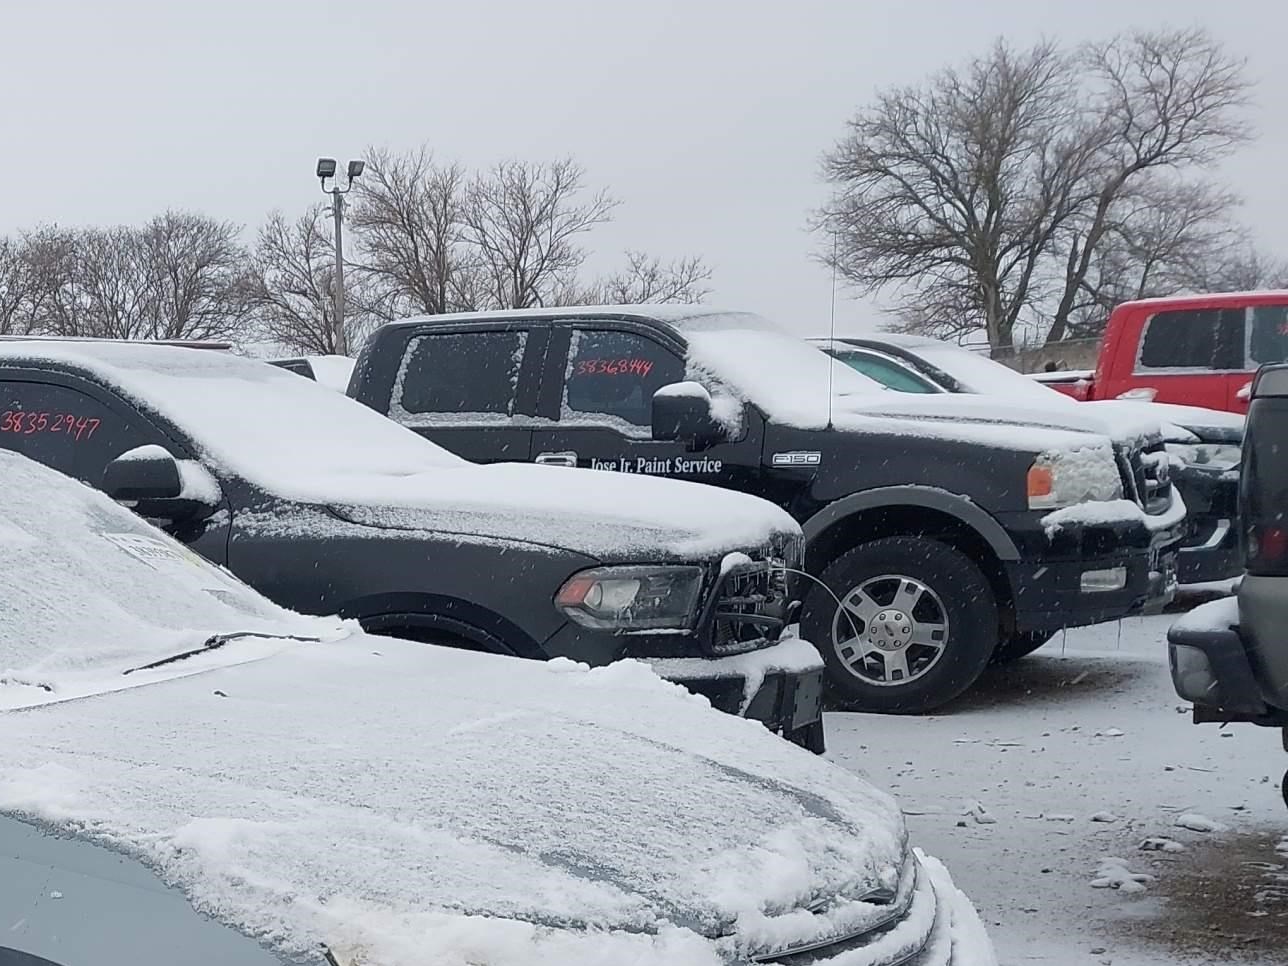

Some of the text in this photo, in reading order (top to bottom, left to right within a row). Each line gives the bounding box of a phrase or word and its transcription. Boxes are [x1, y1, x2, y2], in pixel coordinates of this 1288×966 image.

[578, 359, 654, 377] 38368444
[0, 410, 101, 441] 38352947
[591, 455, 722, 474] Jose Jr. Paint Service
